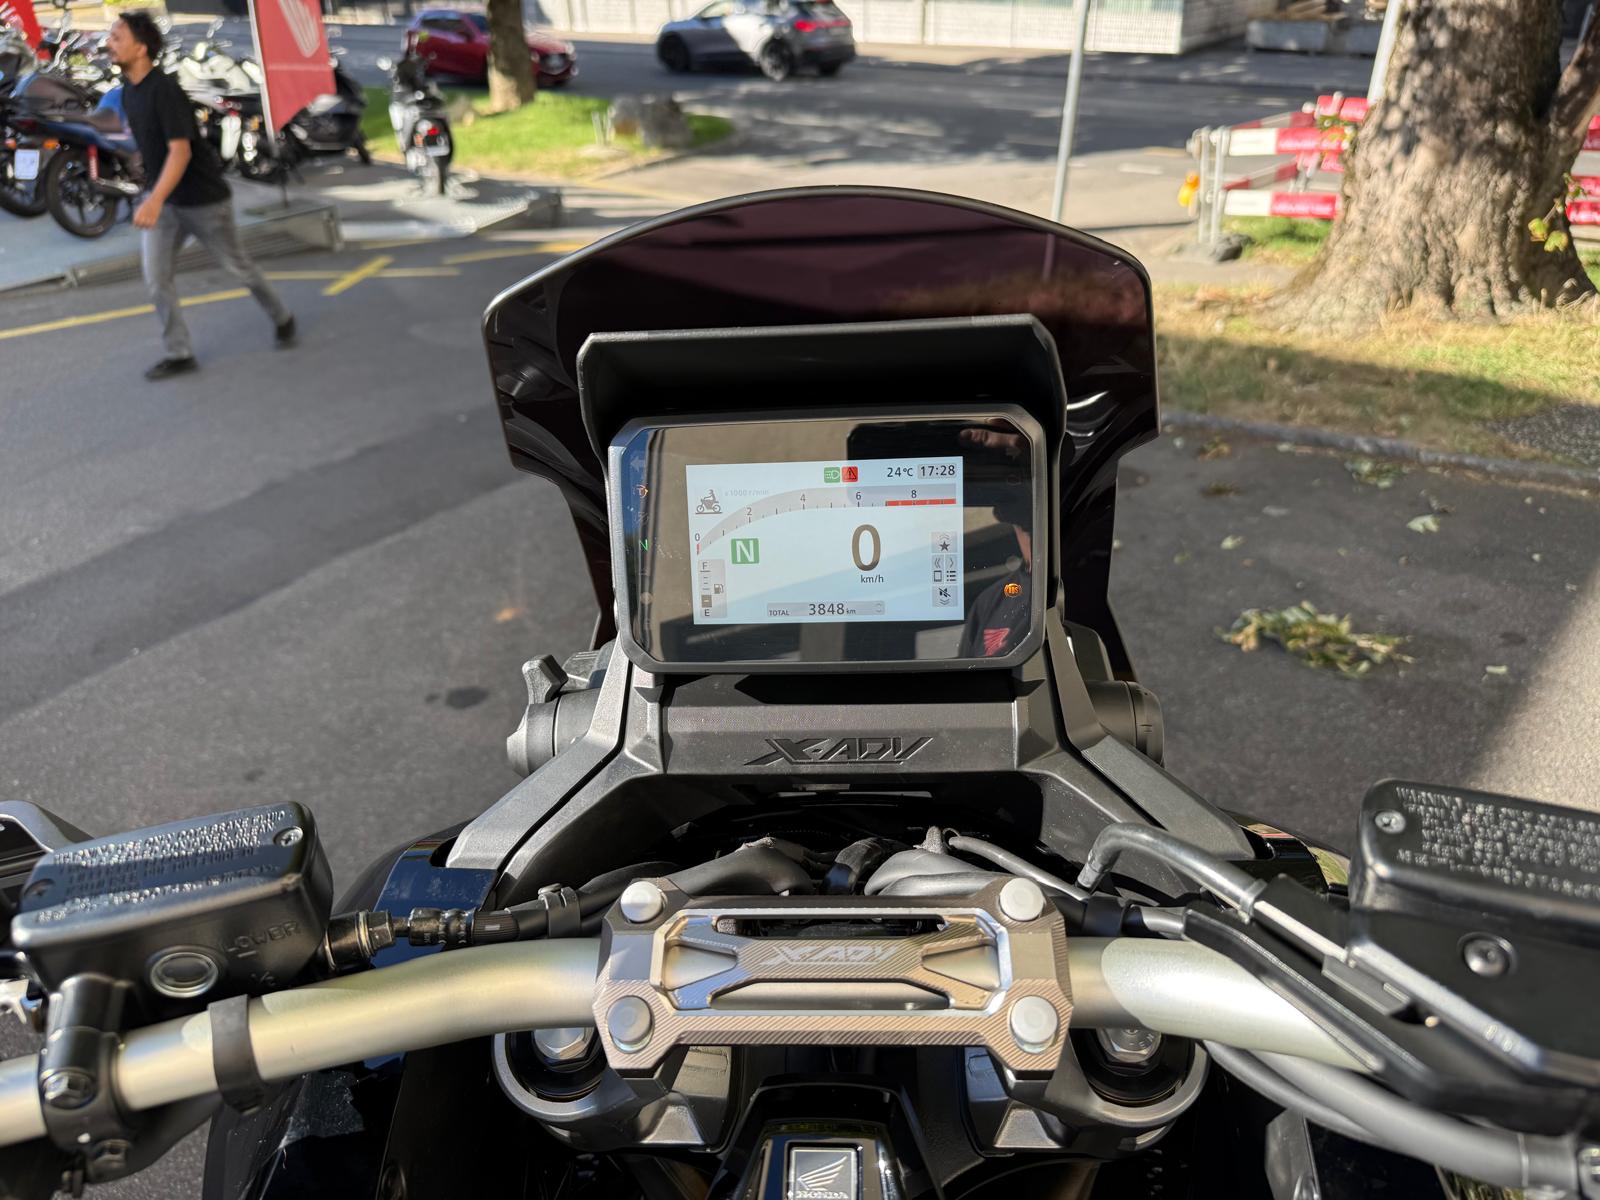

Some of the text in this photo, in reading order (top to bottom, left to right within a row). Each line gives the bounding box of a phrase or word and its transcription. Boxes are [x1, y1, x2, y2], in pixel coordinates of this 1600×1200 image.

[920, 465, 956, 477] 17:28
[799, 493, 806, 502] 4
[855, 491, 862, 501] 6
[910, 489, 918, 499] 8
[746, 507, 753, 516] 2
[694, 532, 701, 542] 0
[736, 541, 754, 562] N
[851, 524, 881, 571] 0
[702, 562, 708, 570] F
[860, 574, 884, 584] km/h
[704, 609, 710, 617] E
[769, 609, 790, 617] TOTAL
[808, 603, 845, 616] 3848
[744, 737, 934, 766] X-ADV
